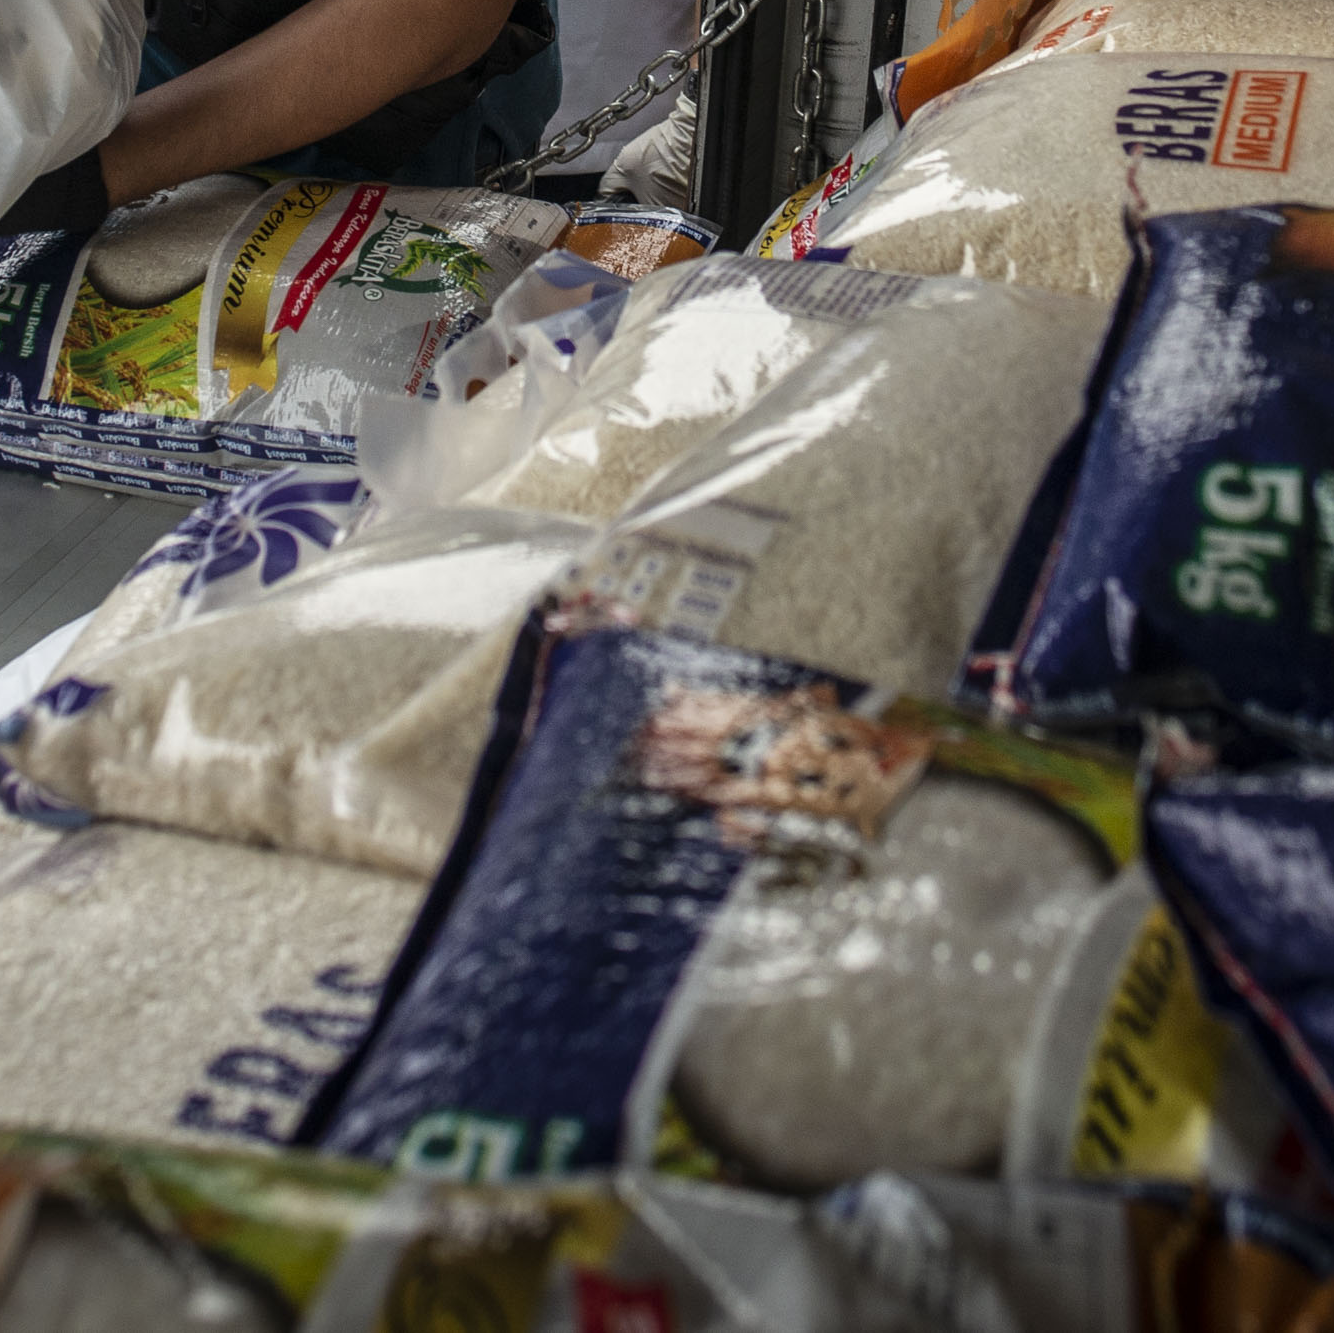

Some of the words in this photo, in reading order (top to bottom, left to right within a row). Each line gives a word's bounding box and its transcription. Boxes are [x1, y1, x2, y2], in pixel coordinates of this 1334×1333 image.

[1115, 69, 1228, 163] BERAS
[1232, 76, 1288, 163] MEDIUM
[223, 181, 333, 315] Premium
[19, 316, 42, 357] Bersih
[404, 372, 425, 398] neg
